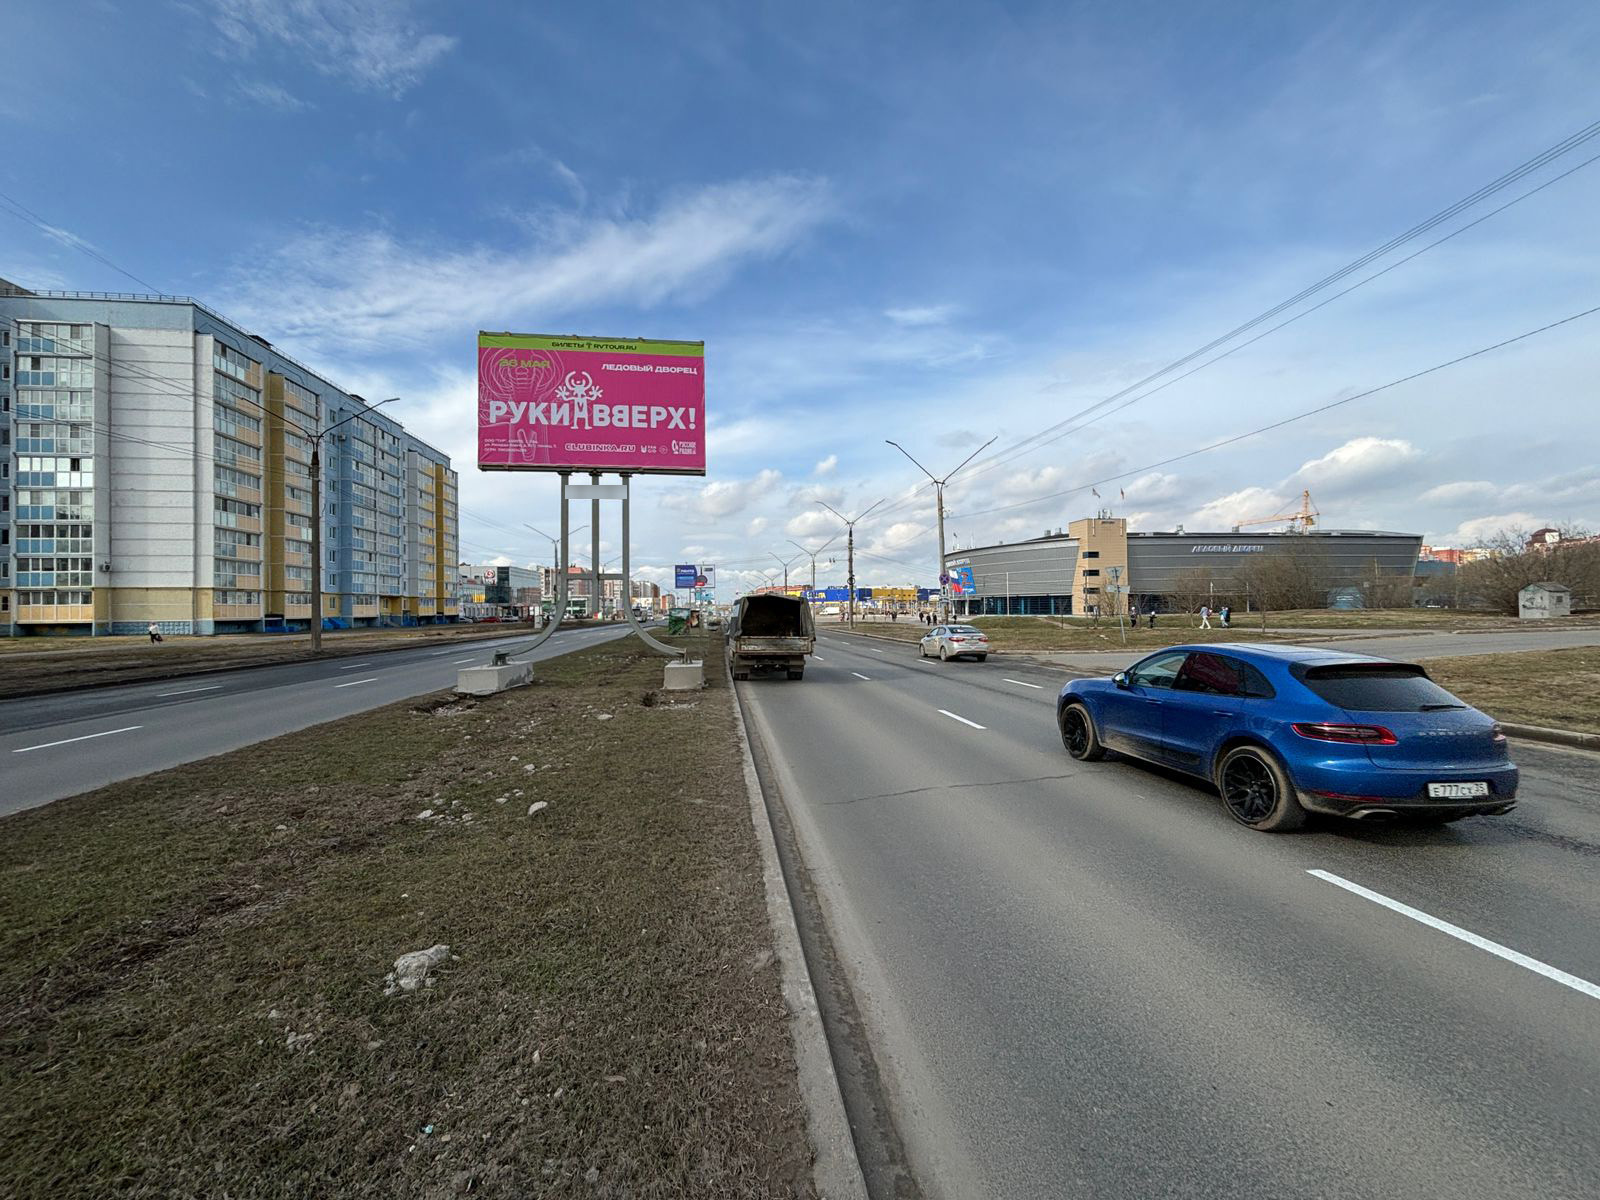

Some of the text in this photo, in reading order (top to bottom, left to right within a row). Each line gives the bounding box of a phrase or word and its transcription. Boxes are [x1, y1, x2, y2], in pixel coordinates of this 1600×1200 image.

[601, 363, 698, 375] ЛЕДОВЫЙ ДВОРЕЦ
[489, 400, 696, 430] РУКИ ВВЕРХ!
[565, 442, 636, 453] CLUBINKA.RU
